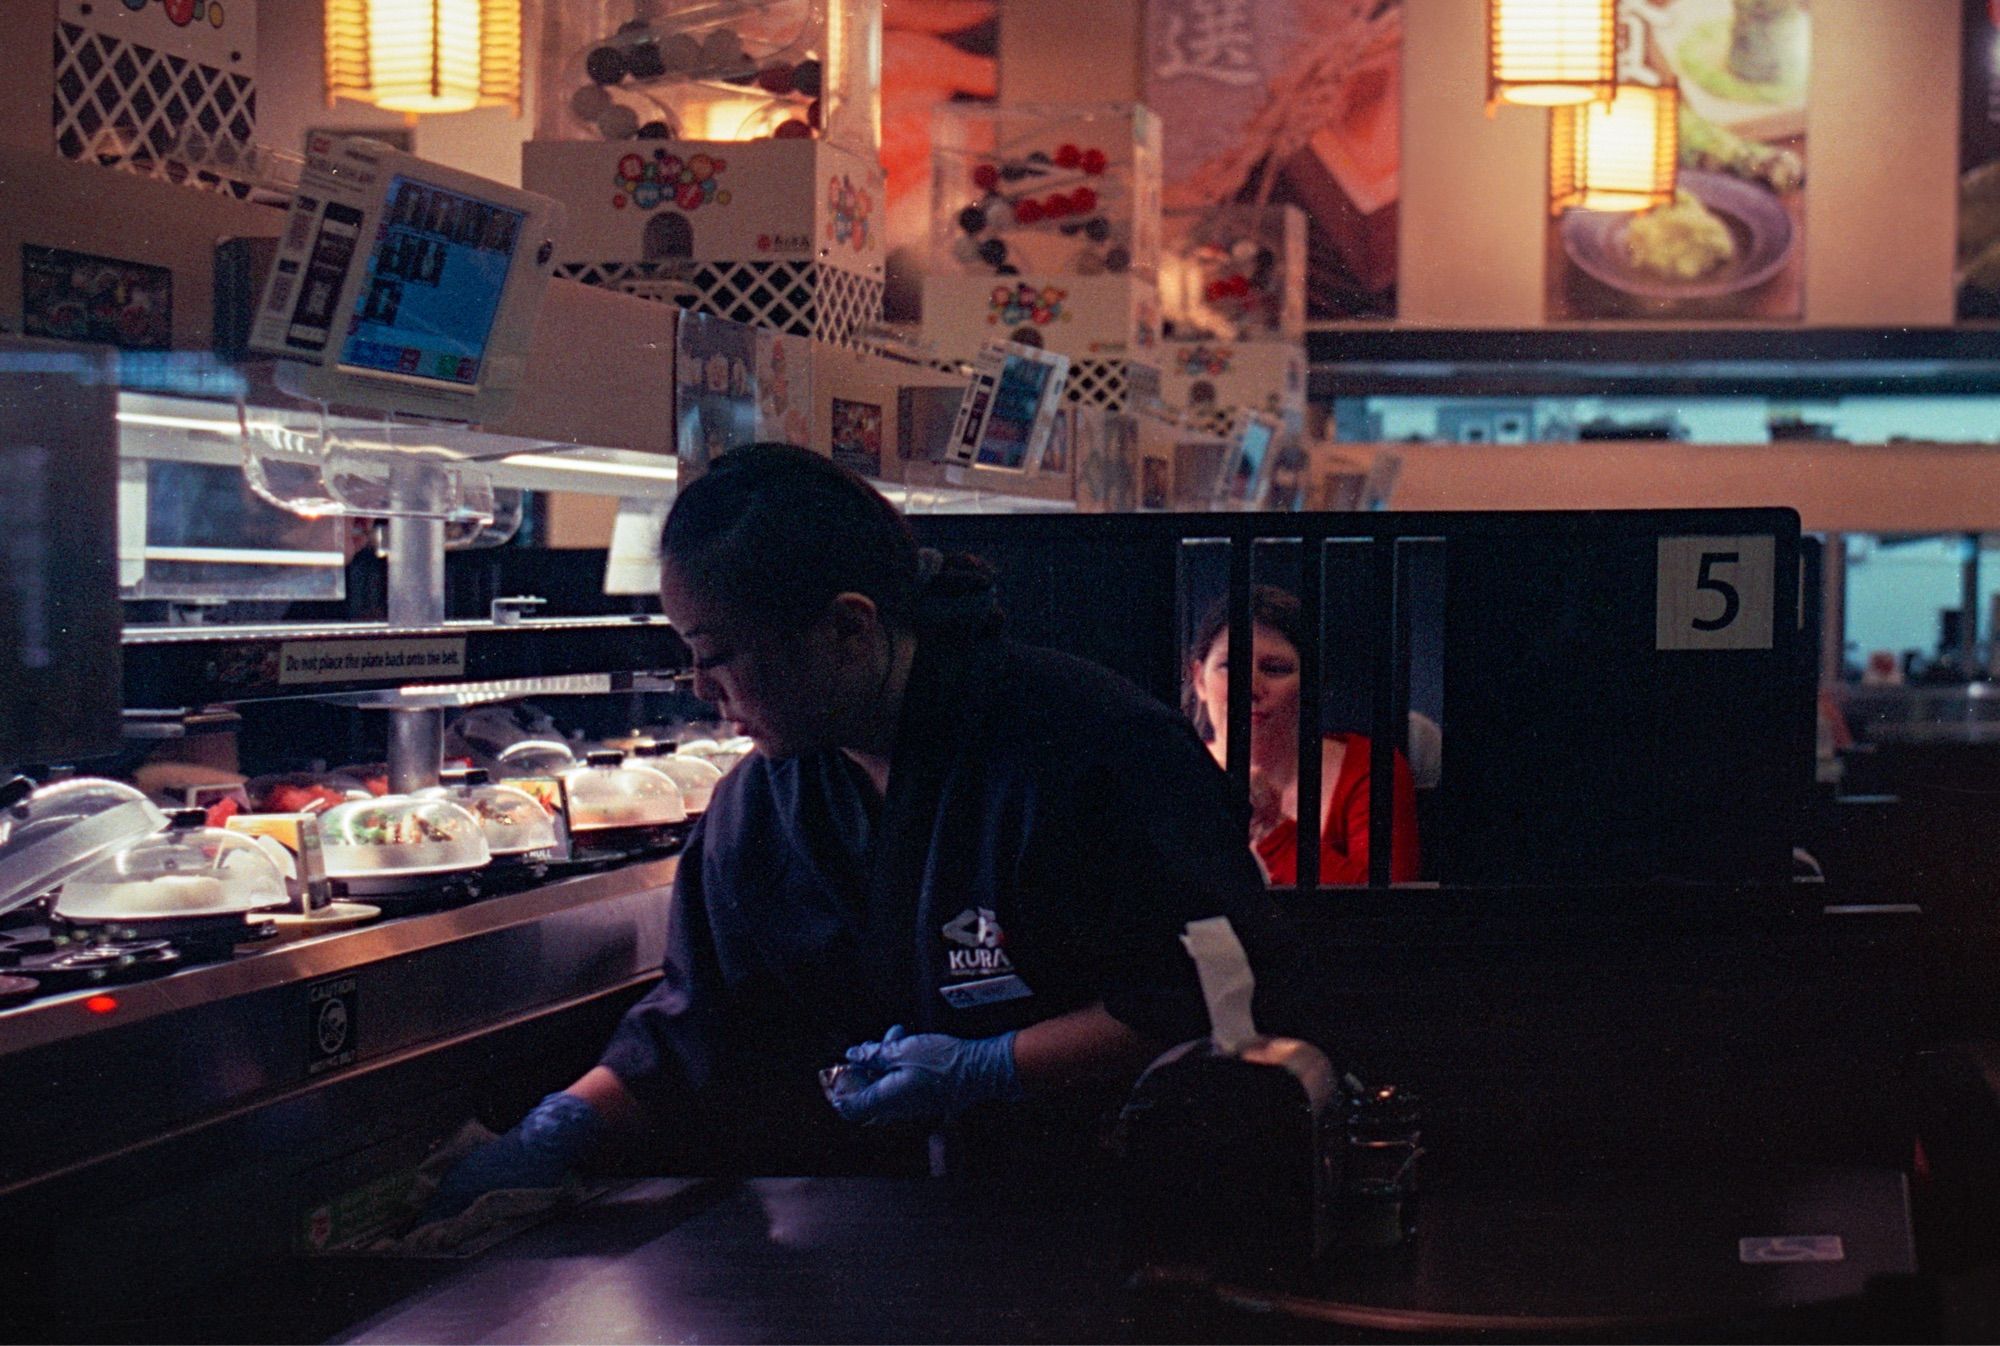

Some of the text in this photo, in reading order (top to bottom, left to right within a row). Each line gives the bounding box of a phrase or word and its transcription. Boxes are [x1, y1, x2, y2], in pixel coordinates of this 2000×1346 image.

[1691, 552, 1739, 631] 5
[286, 655, 299, 671] Do
[302, 656, 317, 670] not
[319, 654, 342, 673] place
[344, 652, 359, 669] the
[361, 651, 384, 670] plate
[385, 650, 404, 667] back
[406, 652, 425, 666] onto
[427, 650, 440, 665] the
[949, 948, 1010, 969] KURA
